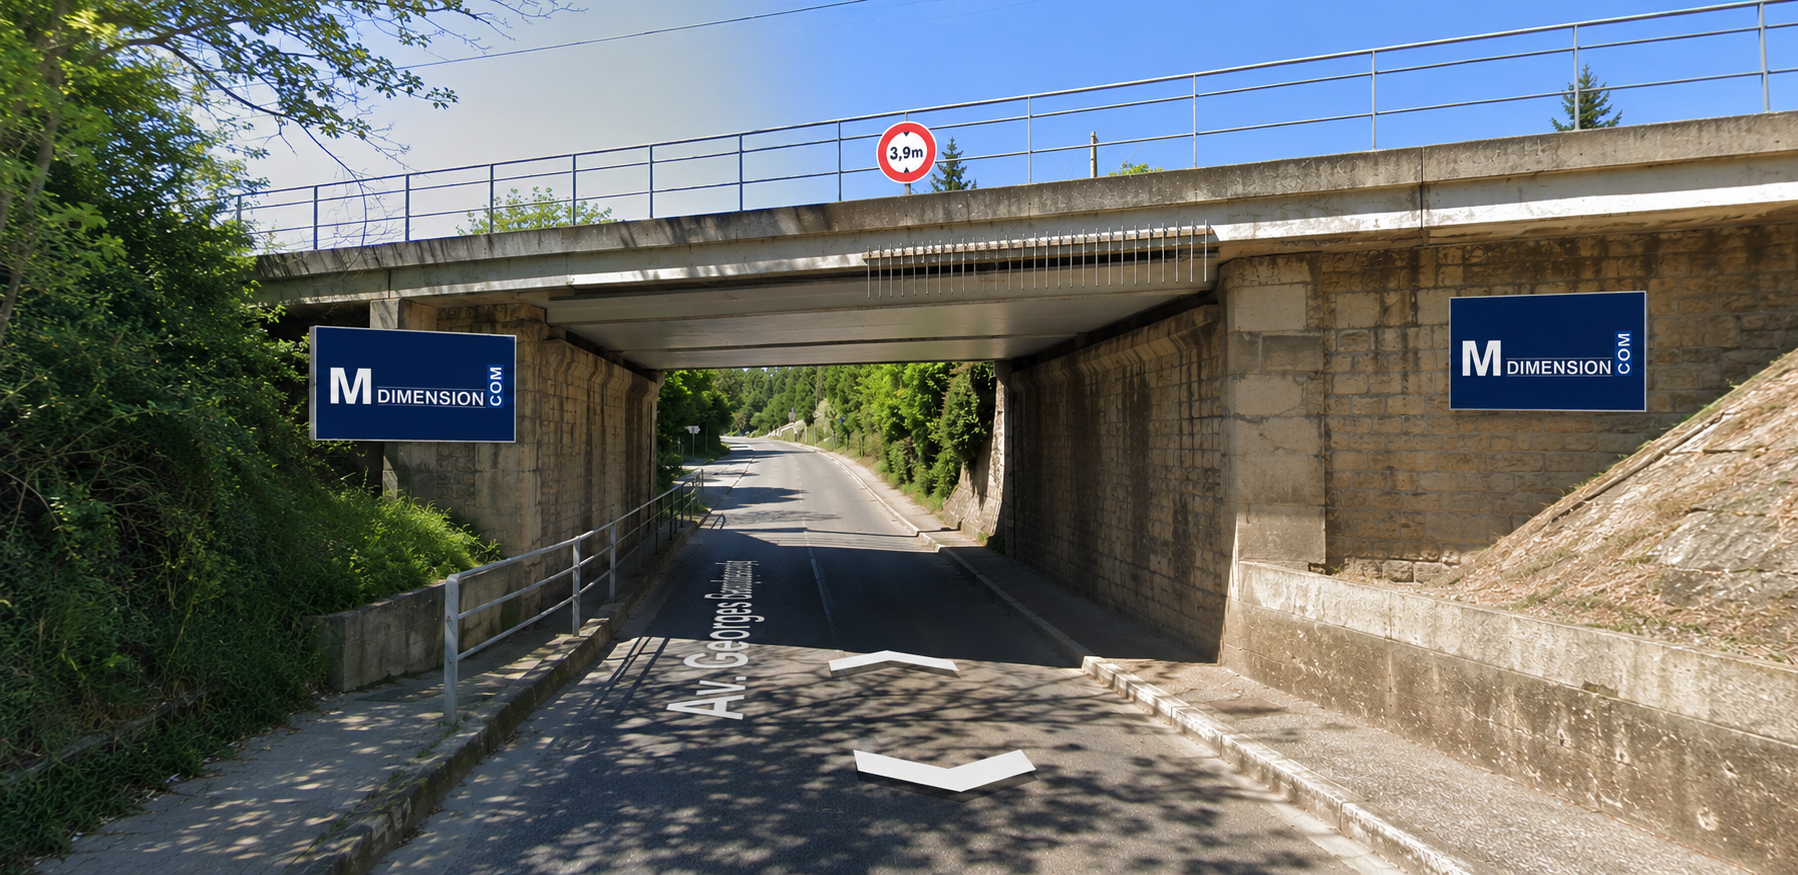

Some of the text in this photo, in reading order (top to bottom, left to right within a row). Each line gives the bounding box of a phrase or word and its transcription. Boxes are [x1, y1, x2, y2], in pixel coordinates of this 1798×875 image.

[890, 146, 923, 161] 3,9m
[1462, 333, 1630, 376] M DIMENSION COM
[330, 367, 502, 406] M DIMENSION COM
